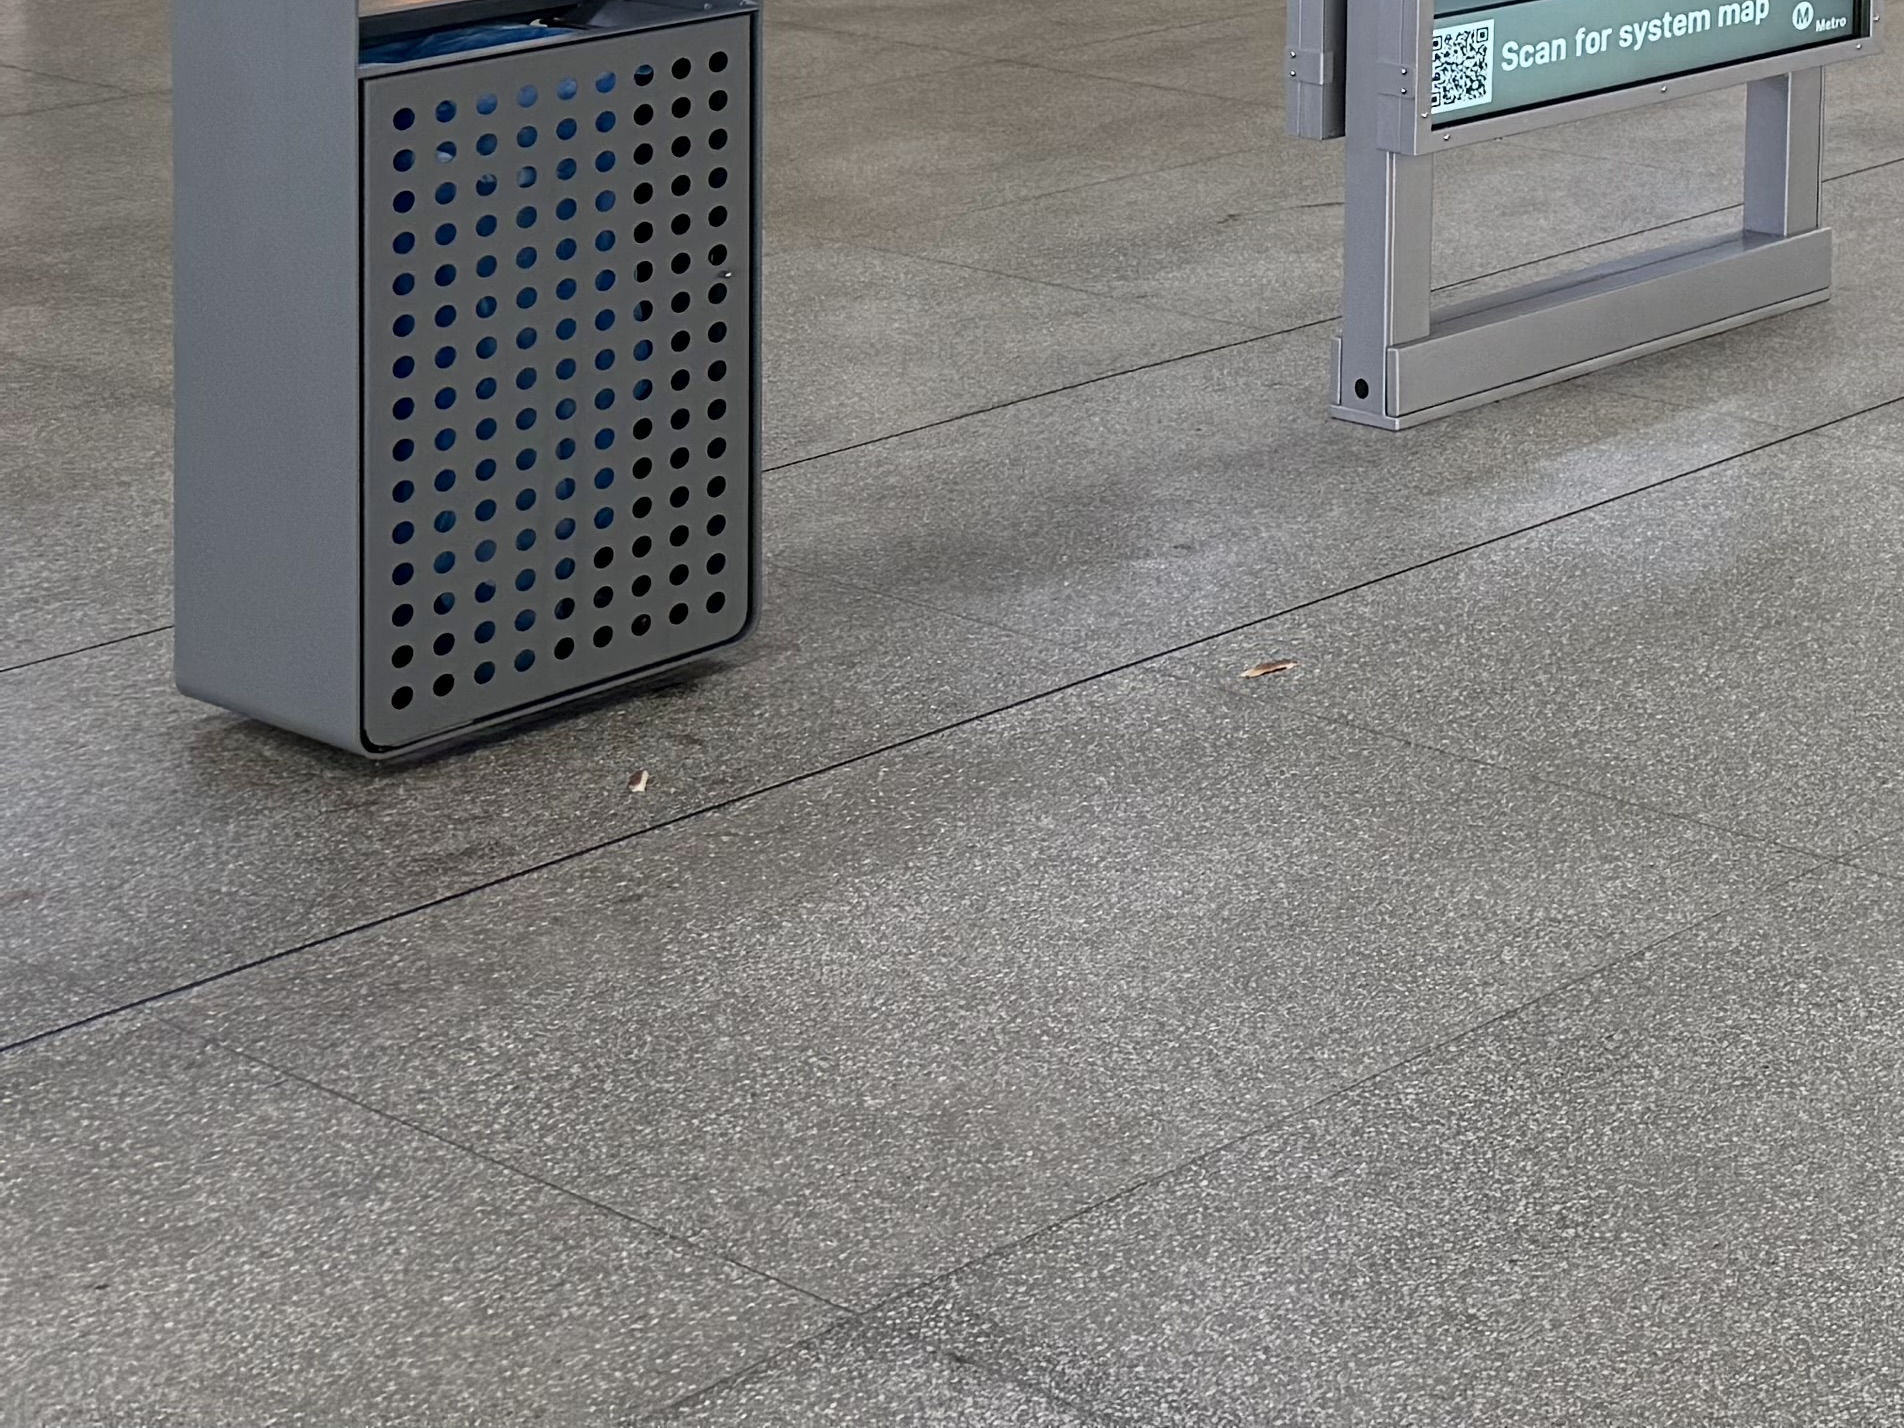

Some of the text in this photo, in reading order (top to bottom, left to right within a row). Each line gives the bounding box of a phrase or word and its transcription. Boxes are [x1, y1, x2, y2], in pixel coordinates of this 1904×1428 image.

[1501, 36, 1567, 72] Scan
[1574, 25, 1610, 58] for
[1618, 7, 1711, 52] system
[1815, 14, 1847, 33] Metro
